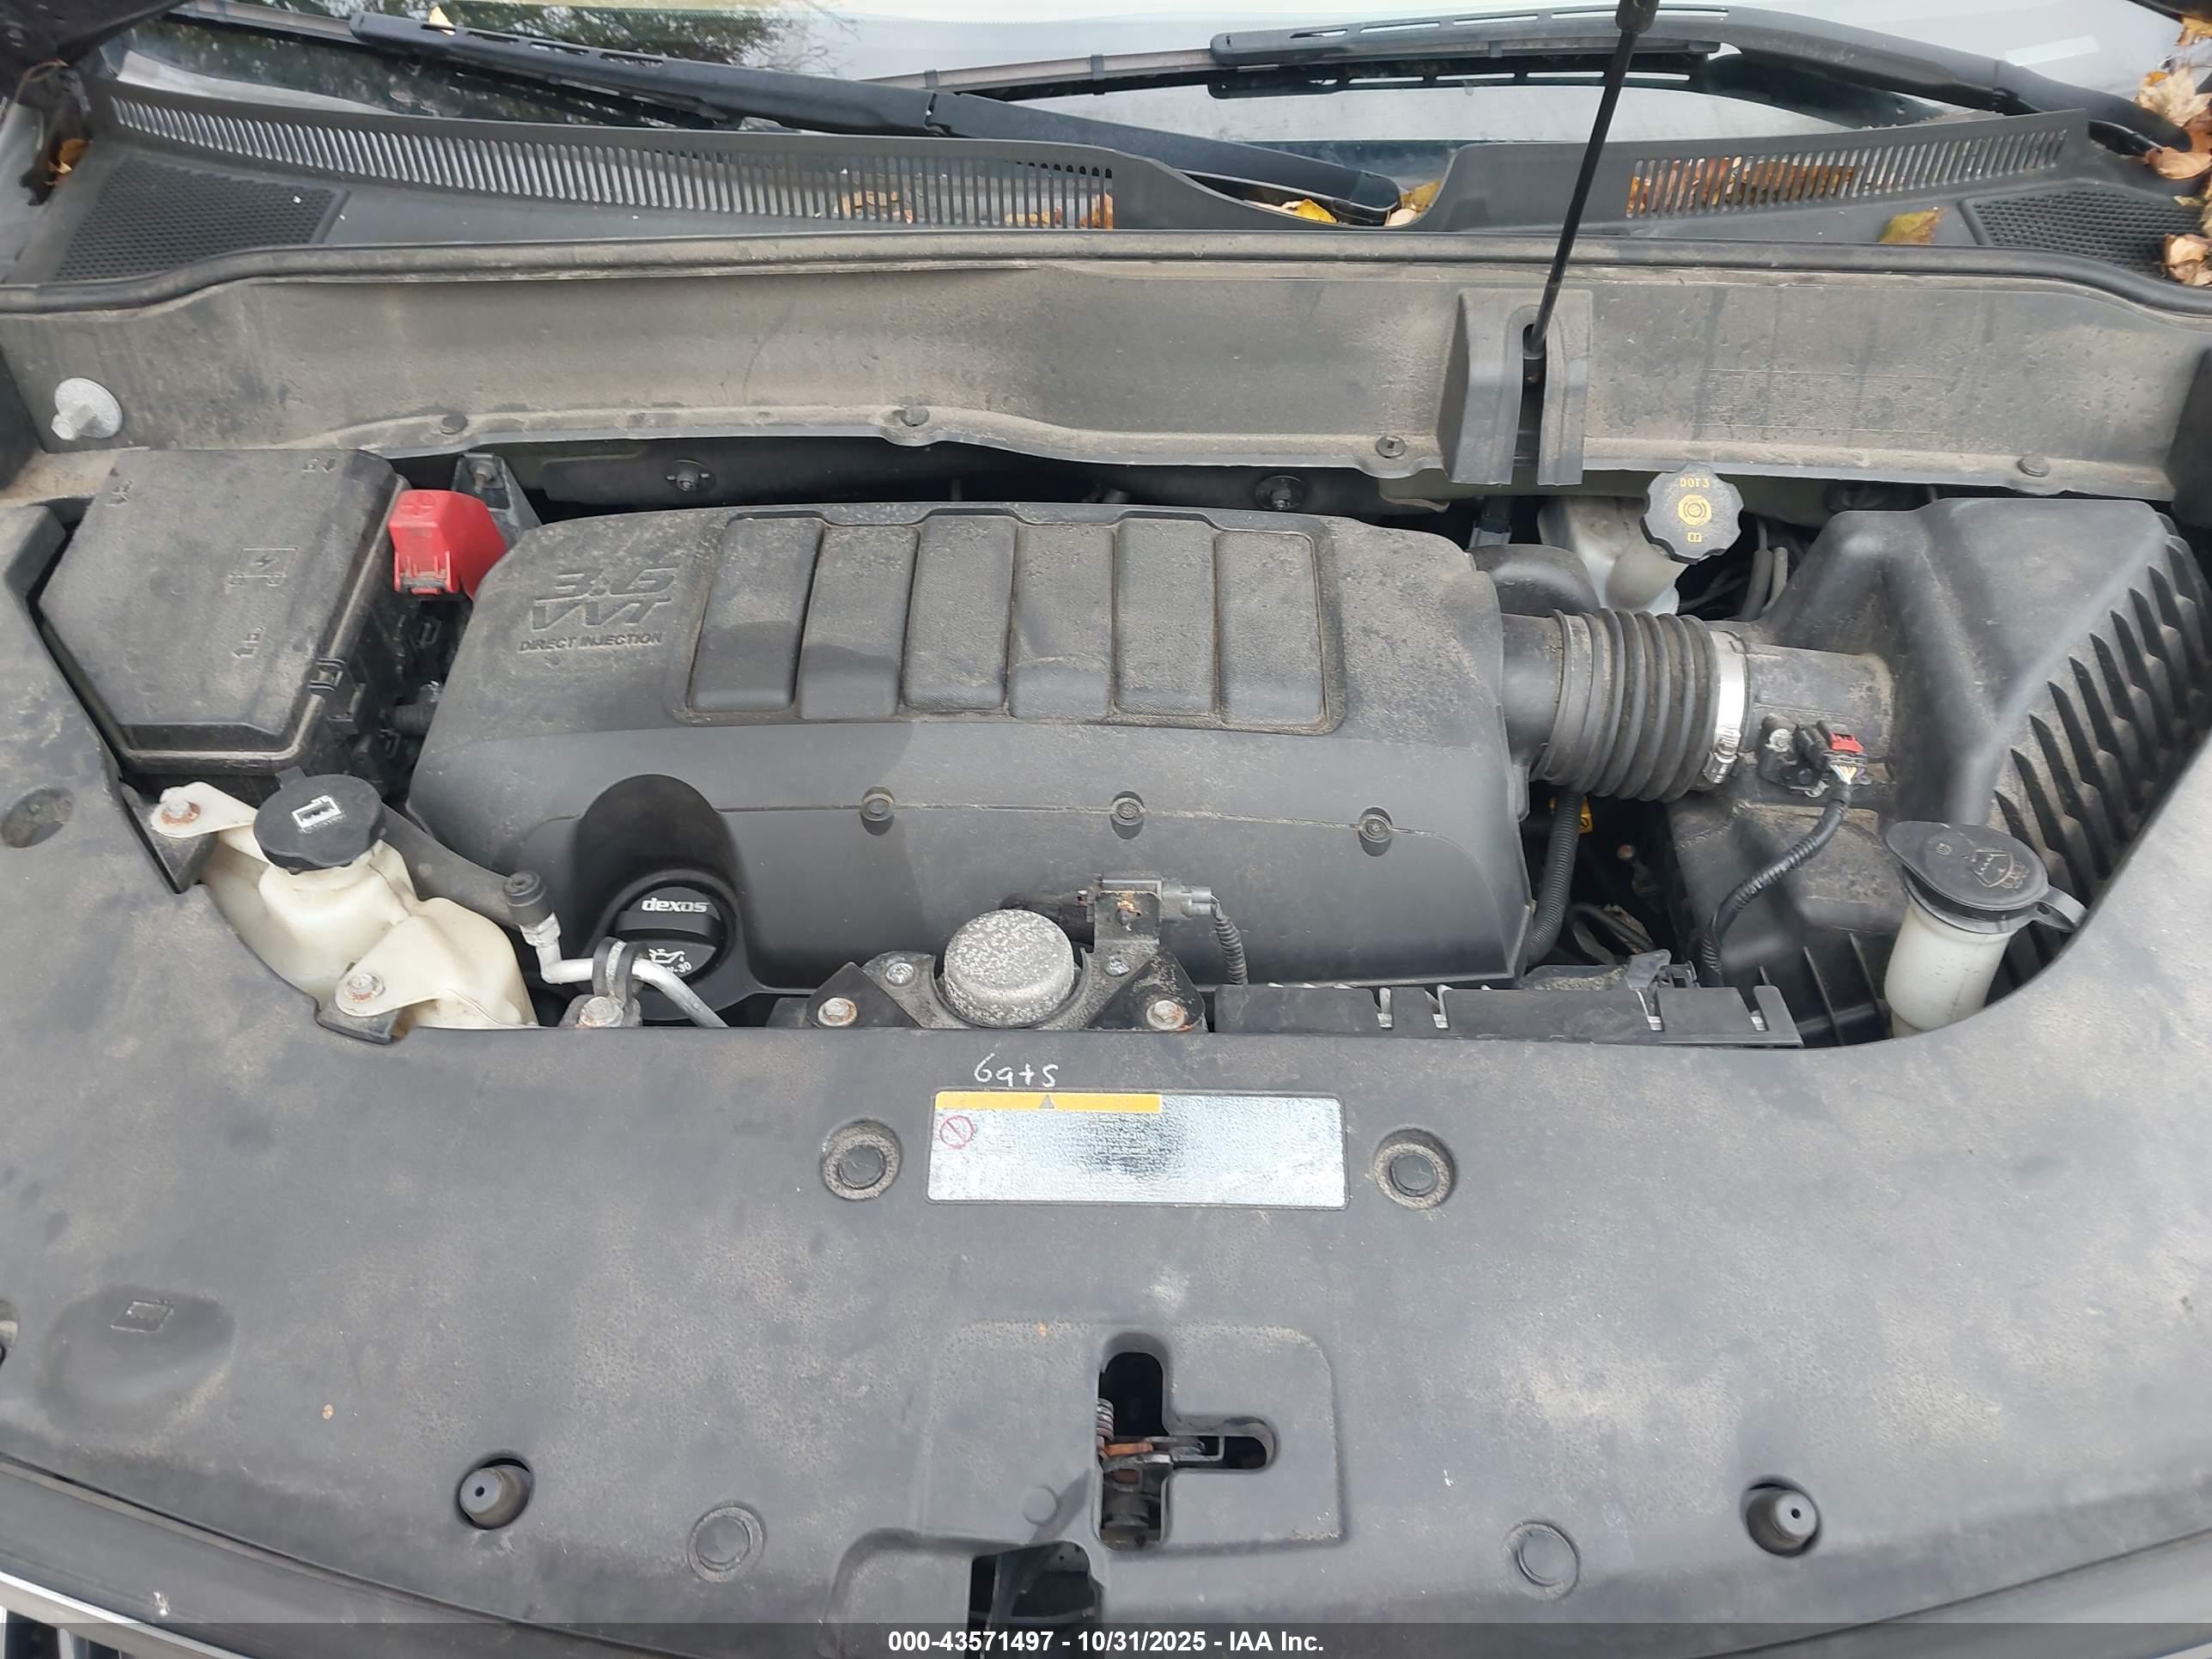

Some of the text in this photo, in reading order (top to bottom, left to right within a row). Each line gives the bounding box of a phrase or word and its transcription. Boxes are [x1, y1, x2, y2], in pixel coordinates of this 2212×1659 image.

[1680, 477, 1710, 489] DOT 3
[534, 567, 679, 602] 3.6
[531, 598, 672, 631] VVT
[518, 632, 663, 653] DIRECT INJECTION
[641, 897, 708, 913] dexos
